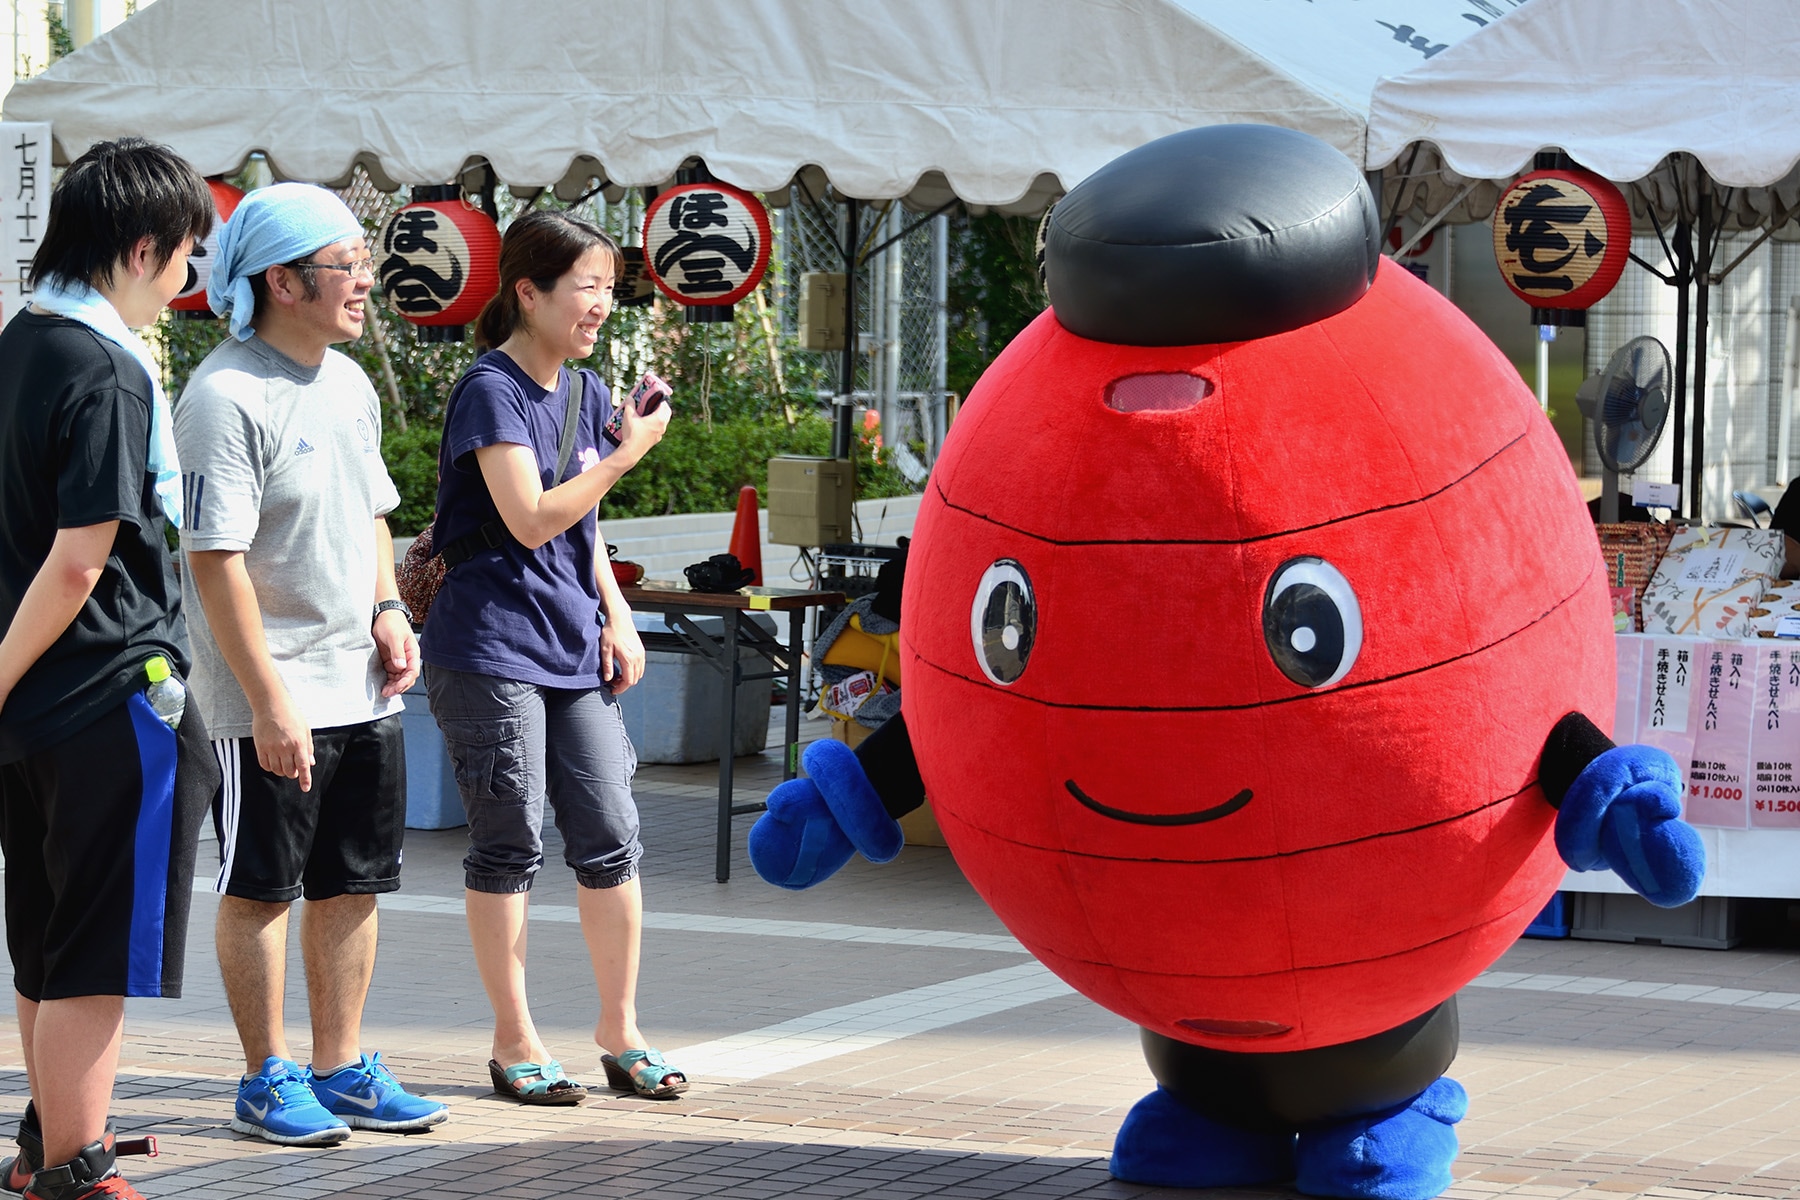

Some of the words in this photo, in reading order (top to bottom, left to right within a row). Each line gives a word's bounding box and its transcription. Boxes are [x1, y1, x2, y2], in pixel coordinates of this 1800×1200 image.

[1653, 648, 1670, 727] 手焼きせんべい
[1676, 650, 1689, 686] 箱入り
[1705, 651, 1723, 730] 手焼きせんべい
[1729, 653, 1743, 689] 箱入り
[1767, 650, 1782, 730] 手焼きせんべい
